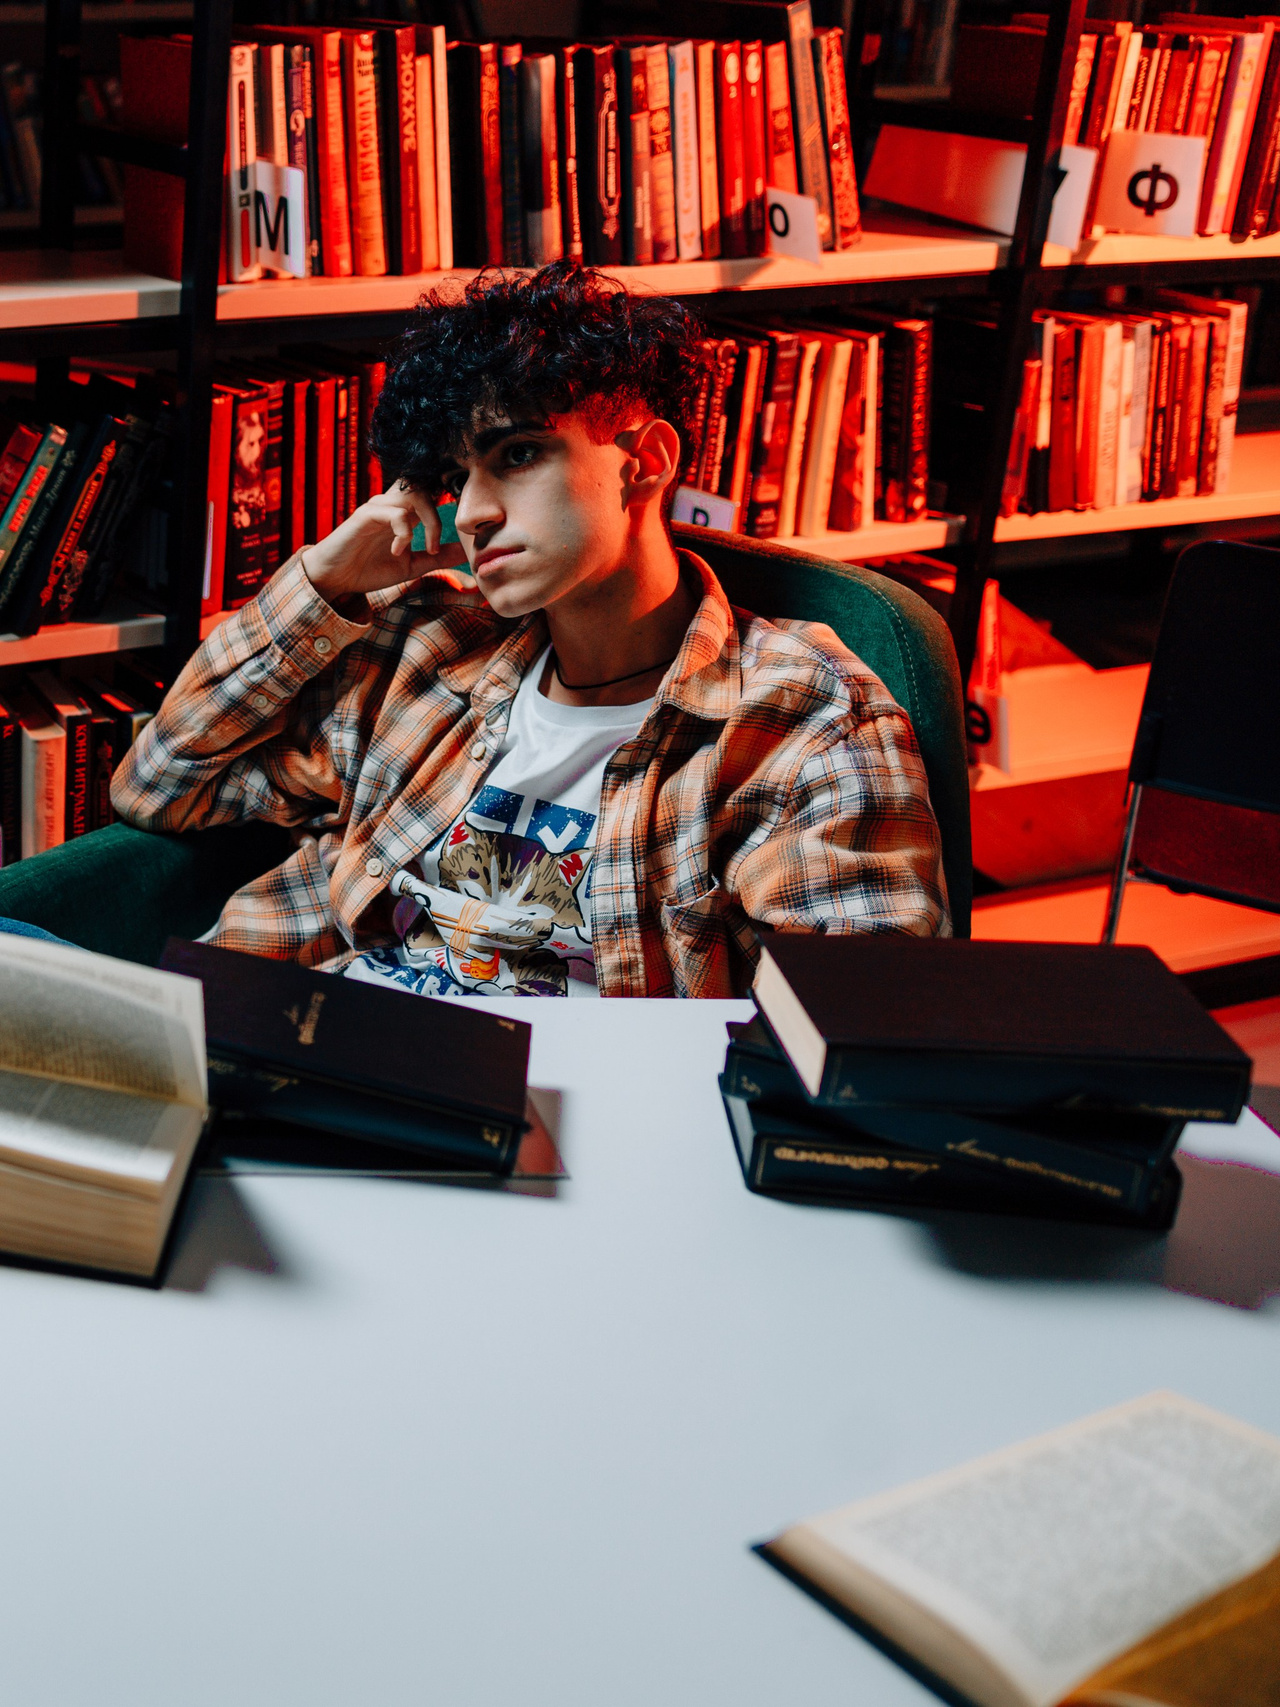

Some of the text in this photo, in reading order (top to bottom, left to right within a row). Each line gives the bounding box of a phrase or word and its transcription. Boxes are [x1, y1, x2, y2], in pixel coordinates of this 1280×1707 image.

[398, 51, 417, 152] ЗАХХОК
[1127, 164, 1180, 217] Ф
[255, 190, 290, 255] М
[75, 723, 87, 763] КОНН
